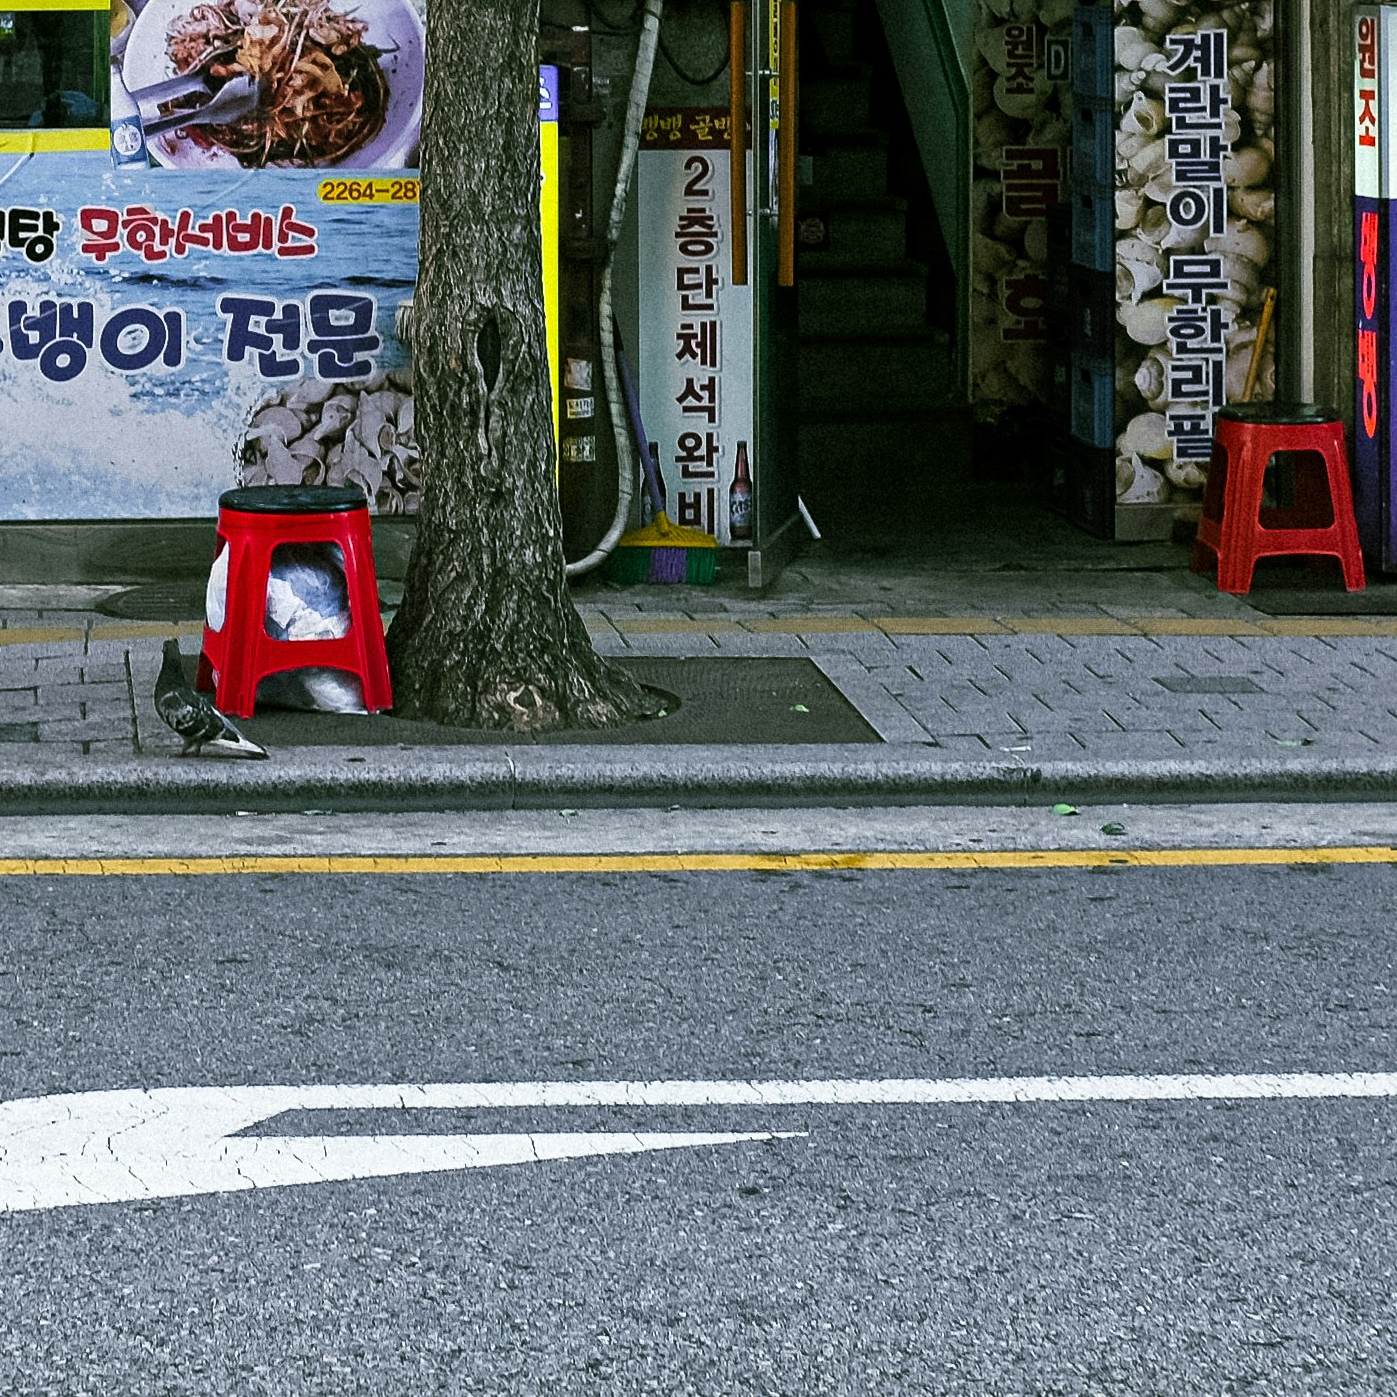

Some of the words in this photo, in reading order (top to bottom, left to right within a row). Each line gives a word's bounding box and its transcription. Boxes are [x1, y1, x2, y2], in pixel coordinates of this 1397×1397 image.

[1165, 28, 1232, 237] 계란말이
[1357, 16, 1377, 148] 원조
[78, 204, 319, 264] 무한서비스
[216, 290, 381, 381] 전문
[1357, 212, 1378, 439] 뱅뱅
